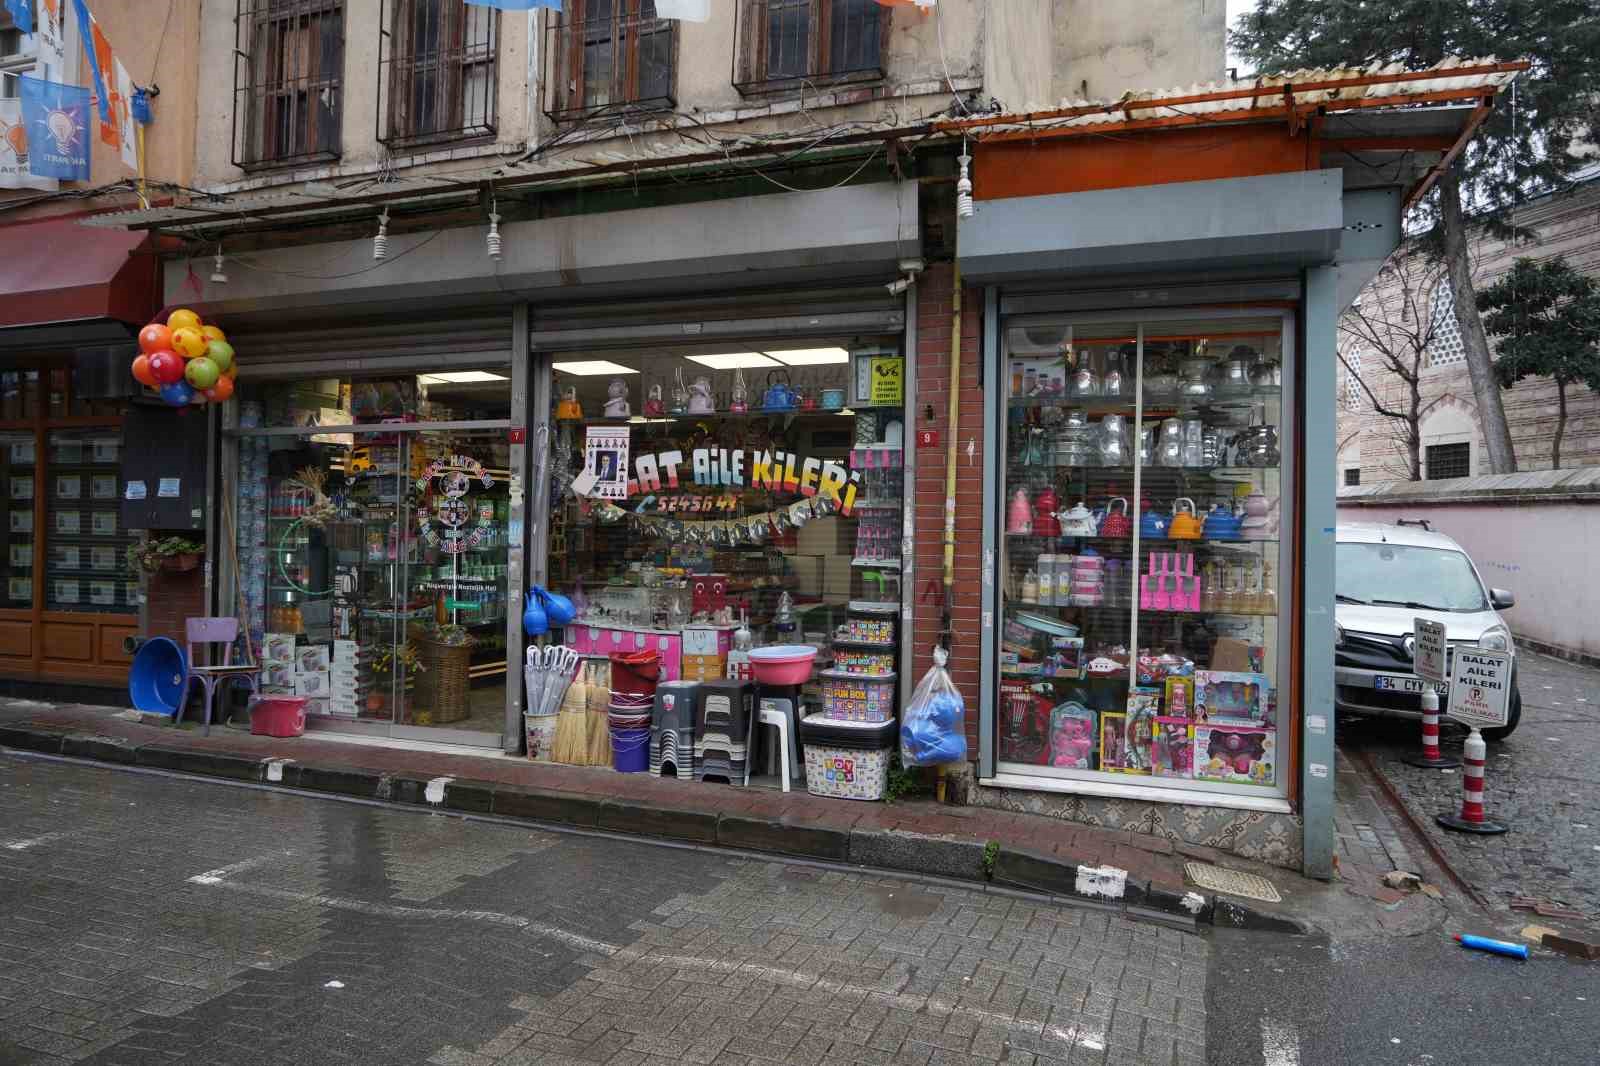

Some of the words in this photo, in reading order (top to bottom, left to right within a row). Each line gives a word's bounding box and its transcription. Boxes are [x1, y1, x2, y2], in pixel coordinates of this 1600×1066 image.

[924, 433, 931, 442] 9
[693, 448, 744, 485] AİLE
[752, 450, 860, 516] KİLERİ
[1462, 655, 1504, 668] BALAT
[1467, 667, 1496, 678] AİLE
[1382, 677, 1395, 689] 34
[1459, 676, 1502, 690] KİLERİ
